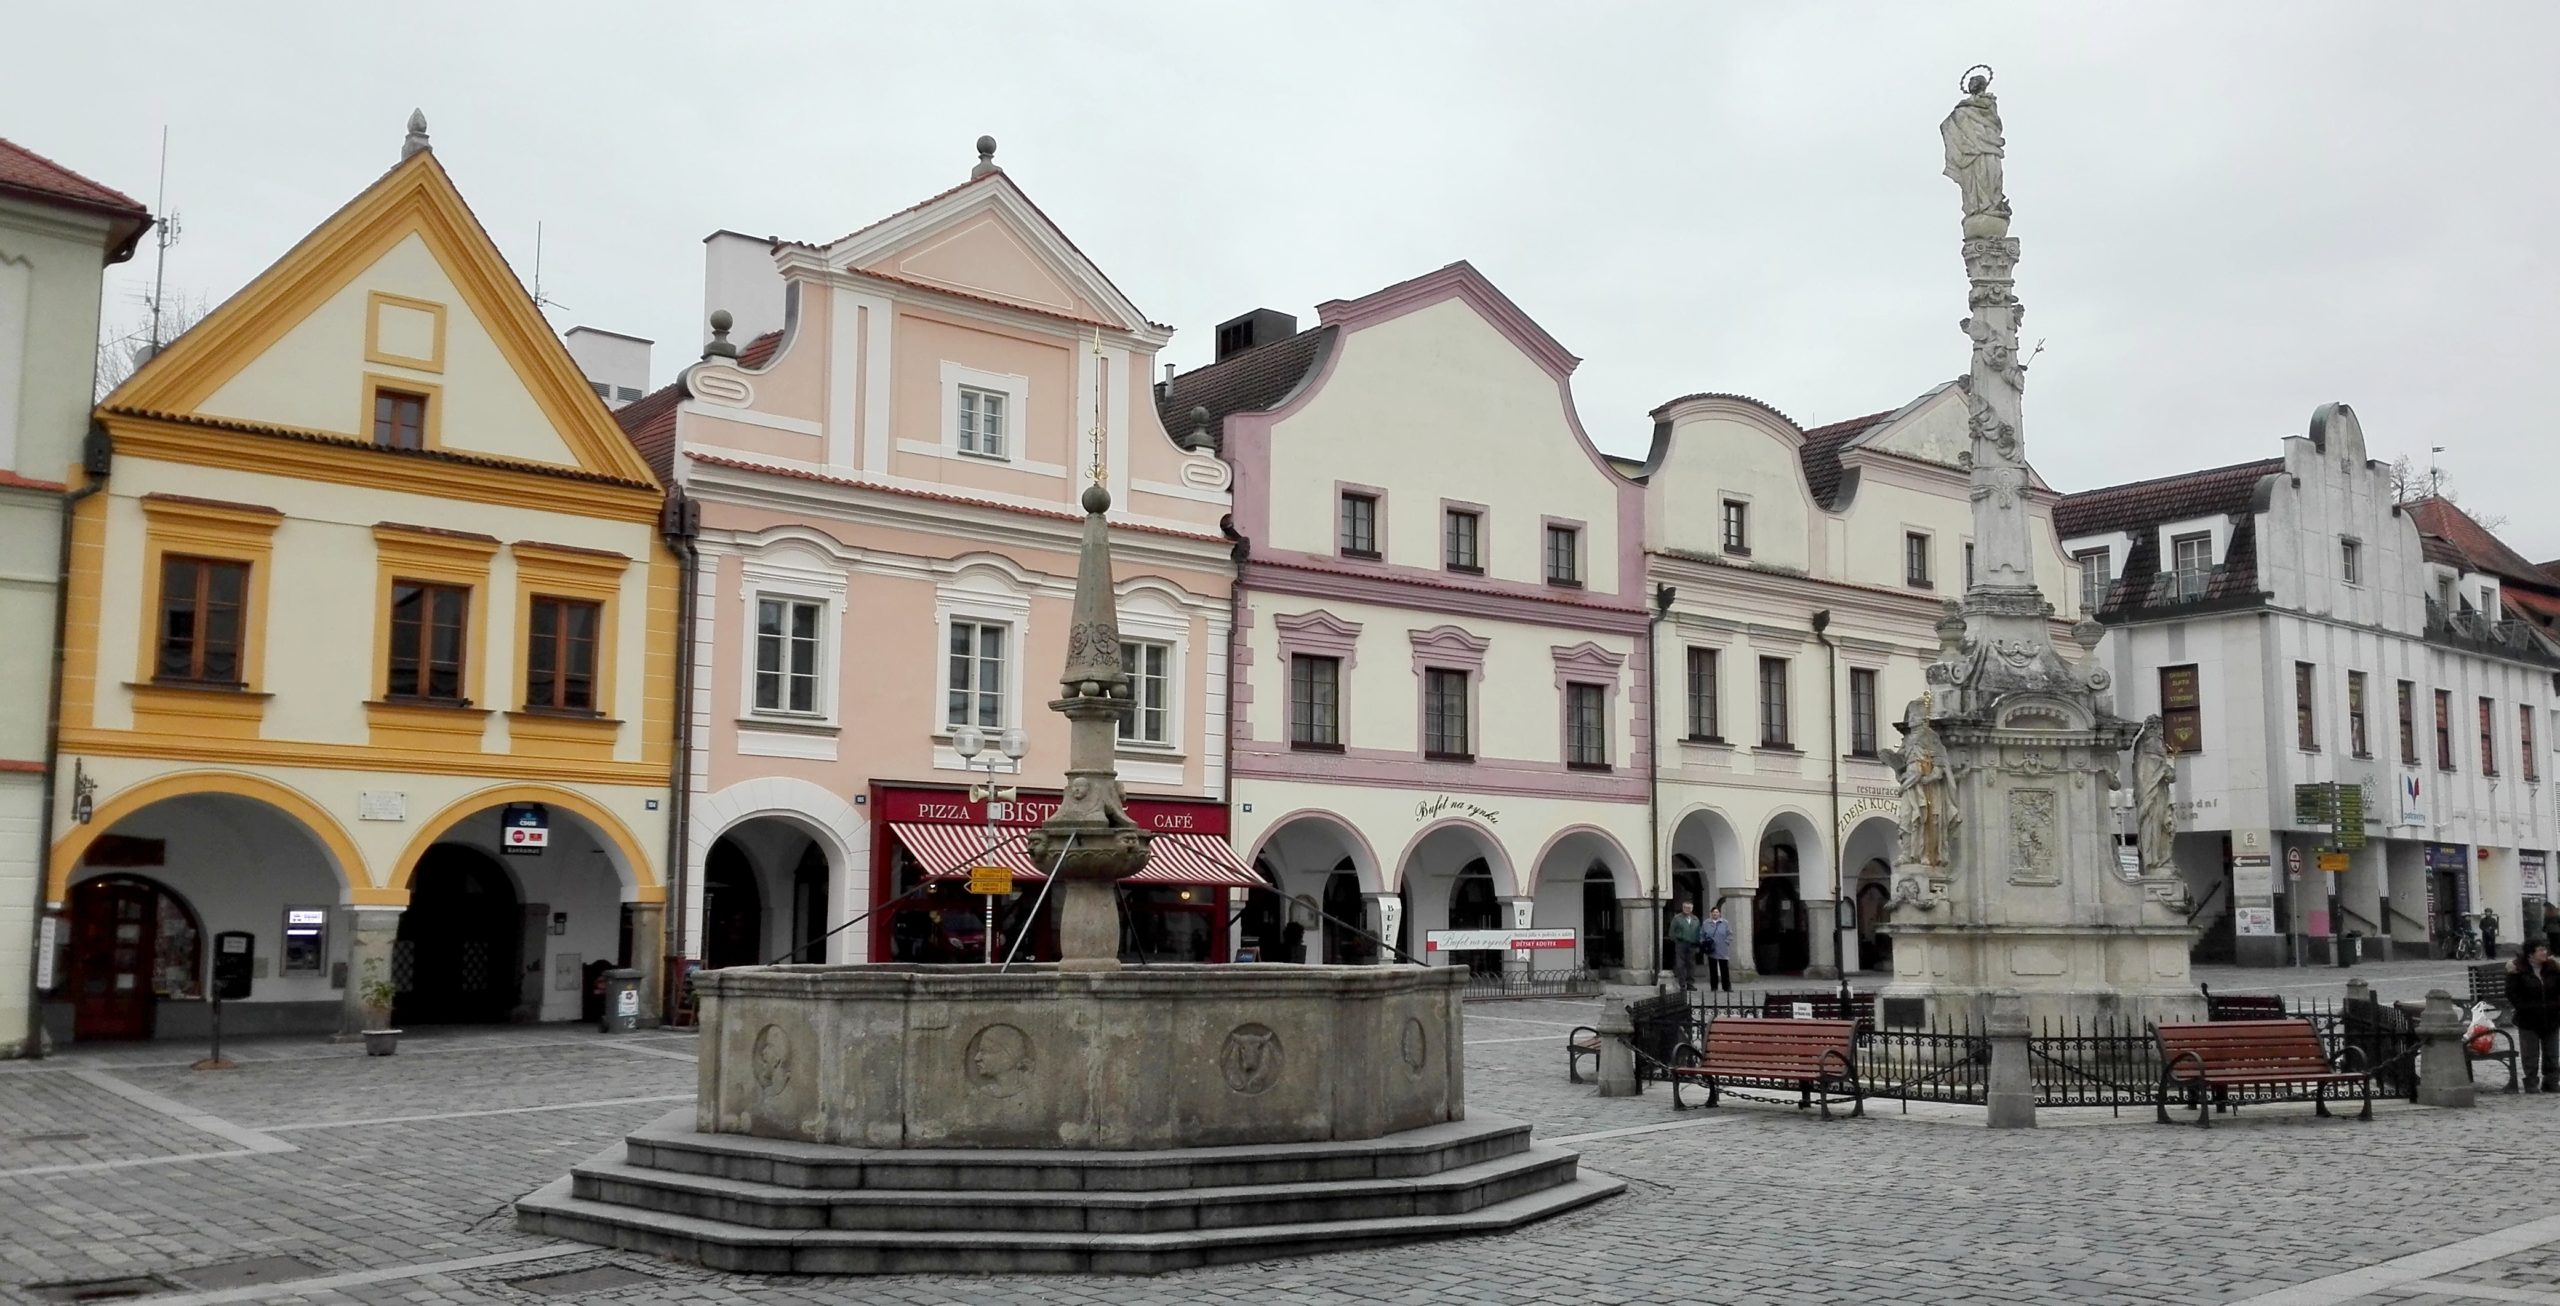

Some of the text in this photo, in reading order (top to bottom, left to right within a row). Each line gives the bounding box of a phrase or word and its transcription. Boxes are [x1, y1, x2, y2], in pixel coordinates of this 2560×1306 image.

[1857, 785, 1899, 796] restaurace
[918, 803, 970, 820] PIZZA
[1000, 801, 1061, 823] BIST
[1415, 794, 1500, 824] Bufet na rynku
[1838, 798, 1899, 832] ZDEJŠÍ KUCH
[1153, 812, 1194, 829] CAFÉ
[1483, 934, 1511, 949] rynk
